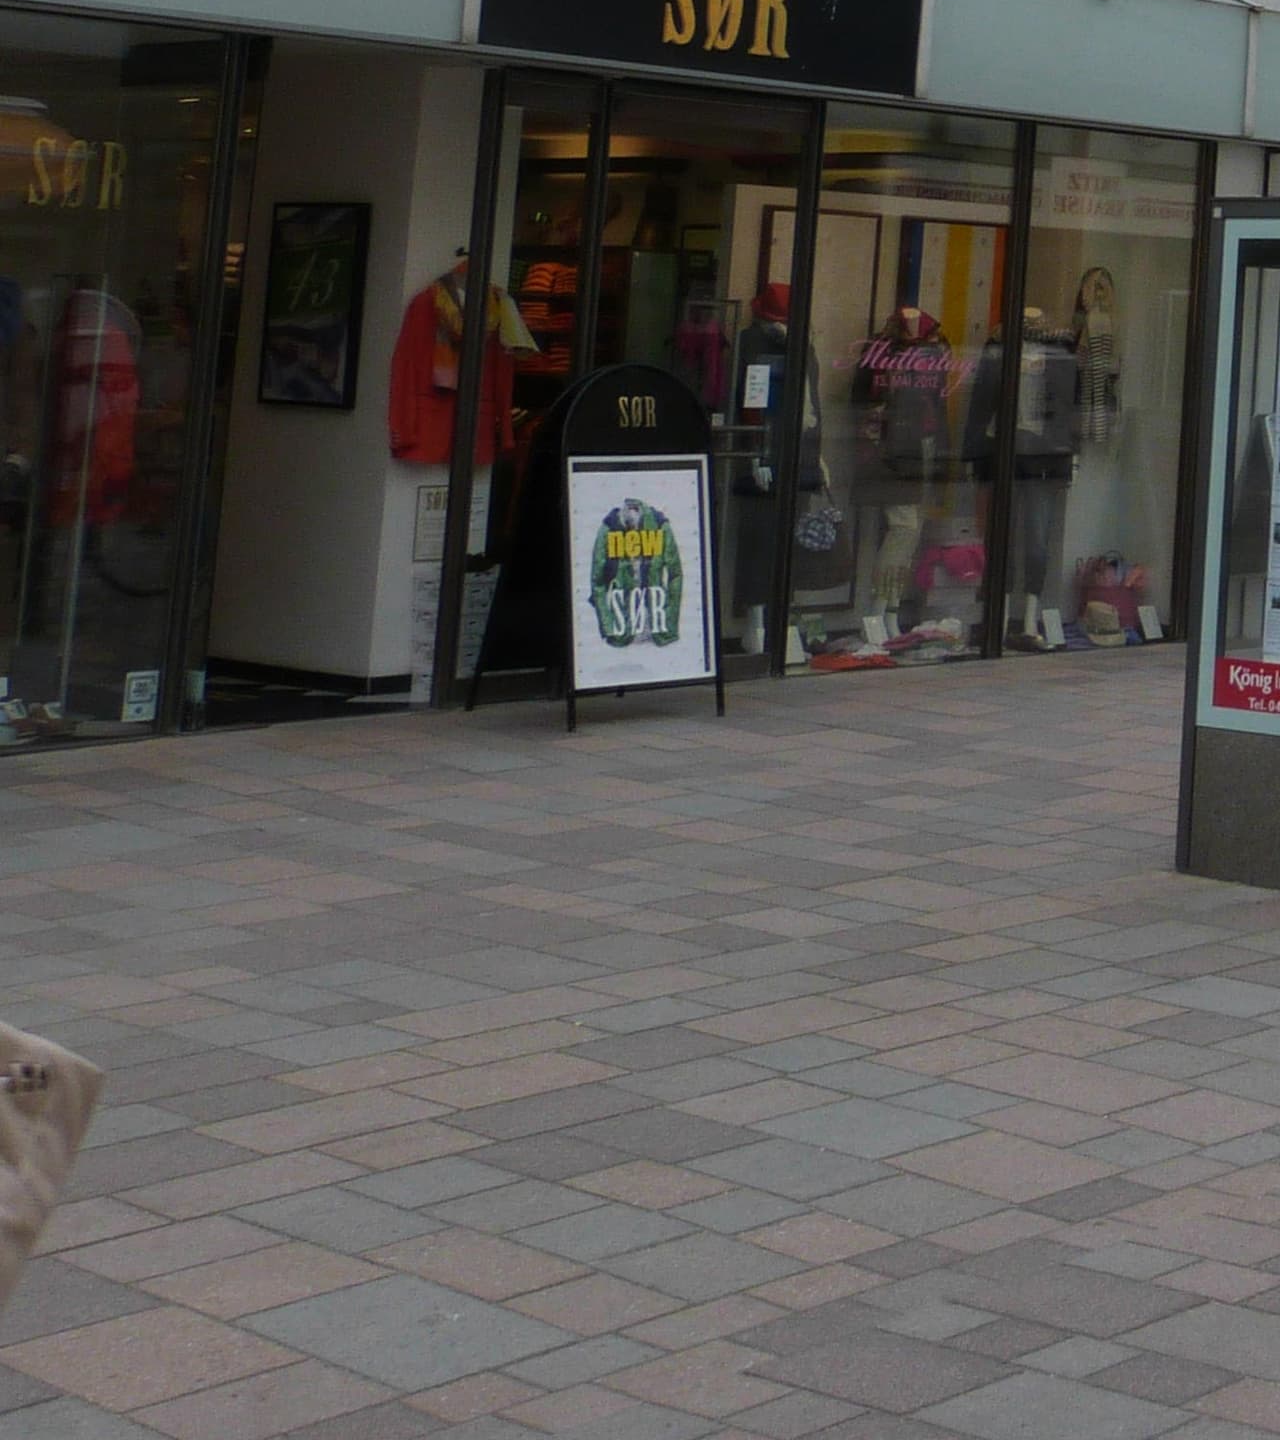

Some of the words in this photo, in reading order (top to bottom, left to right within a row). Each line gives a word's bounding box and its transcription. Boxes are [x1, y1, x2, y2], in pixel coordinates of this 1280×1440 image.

[618, 395, 657, 428] SØR
[607, 528, 665, 558] new
[608, 585, 668, 637] SØR
[1229, 664, 1274, 695] König
[1248, 696, 1268, 712] Tel.
